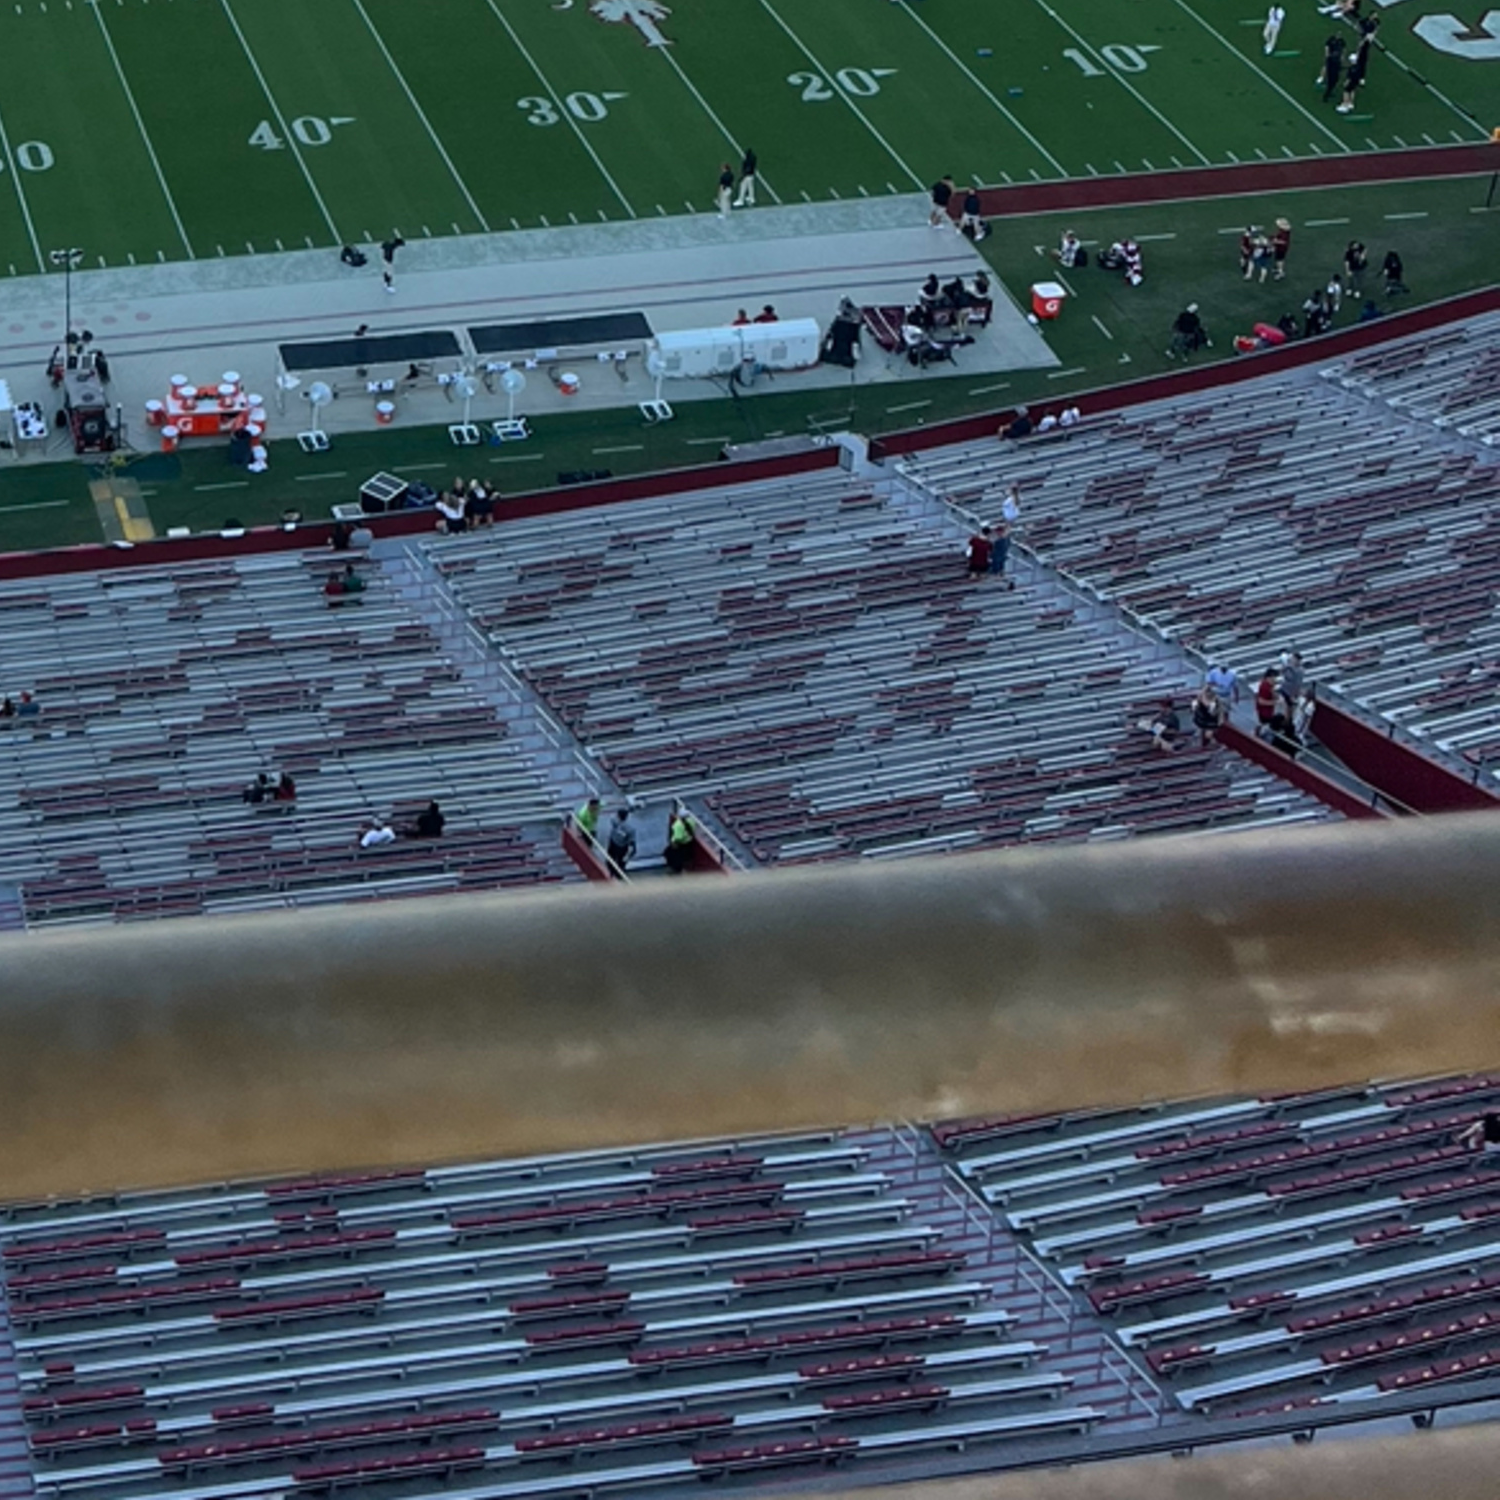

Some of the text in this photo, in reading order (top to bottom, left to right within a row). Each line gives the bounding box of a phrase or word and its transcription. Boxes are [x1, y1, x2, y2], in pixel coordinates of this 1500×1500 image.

[1062, 44, 1150, 77] 10
[787, 68, 884, 101] 20
[517, 91, 608, 127] 30
[247, 116, 333, 150] 40
[177, 416, 194, 432] G
